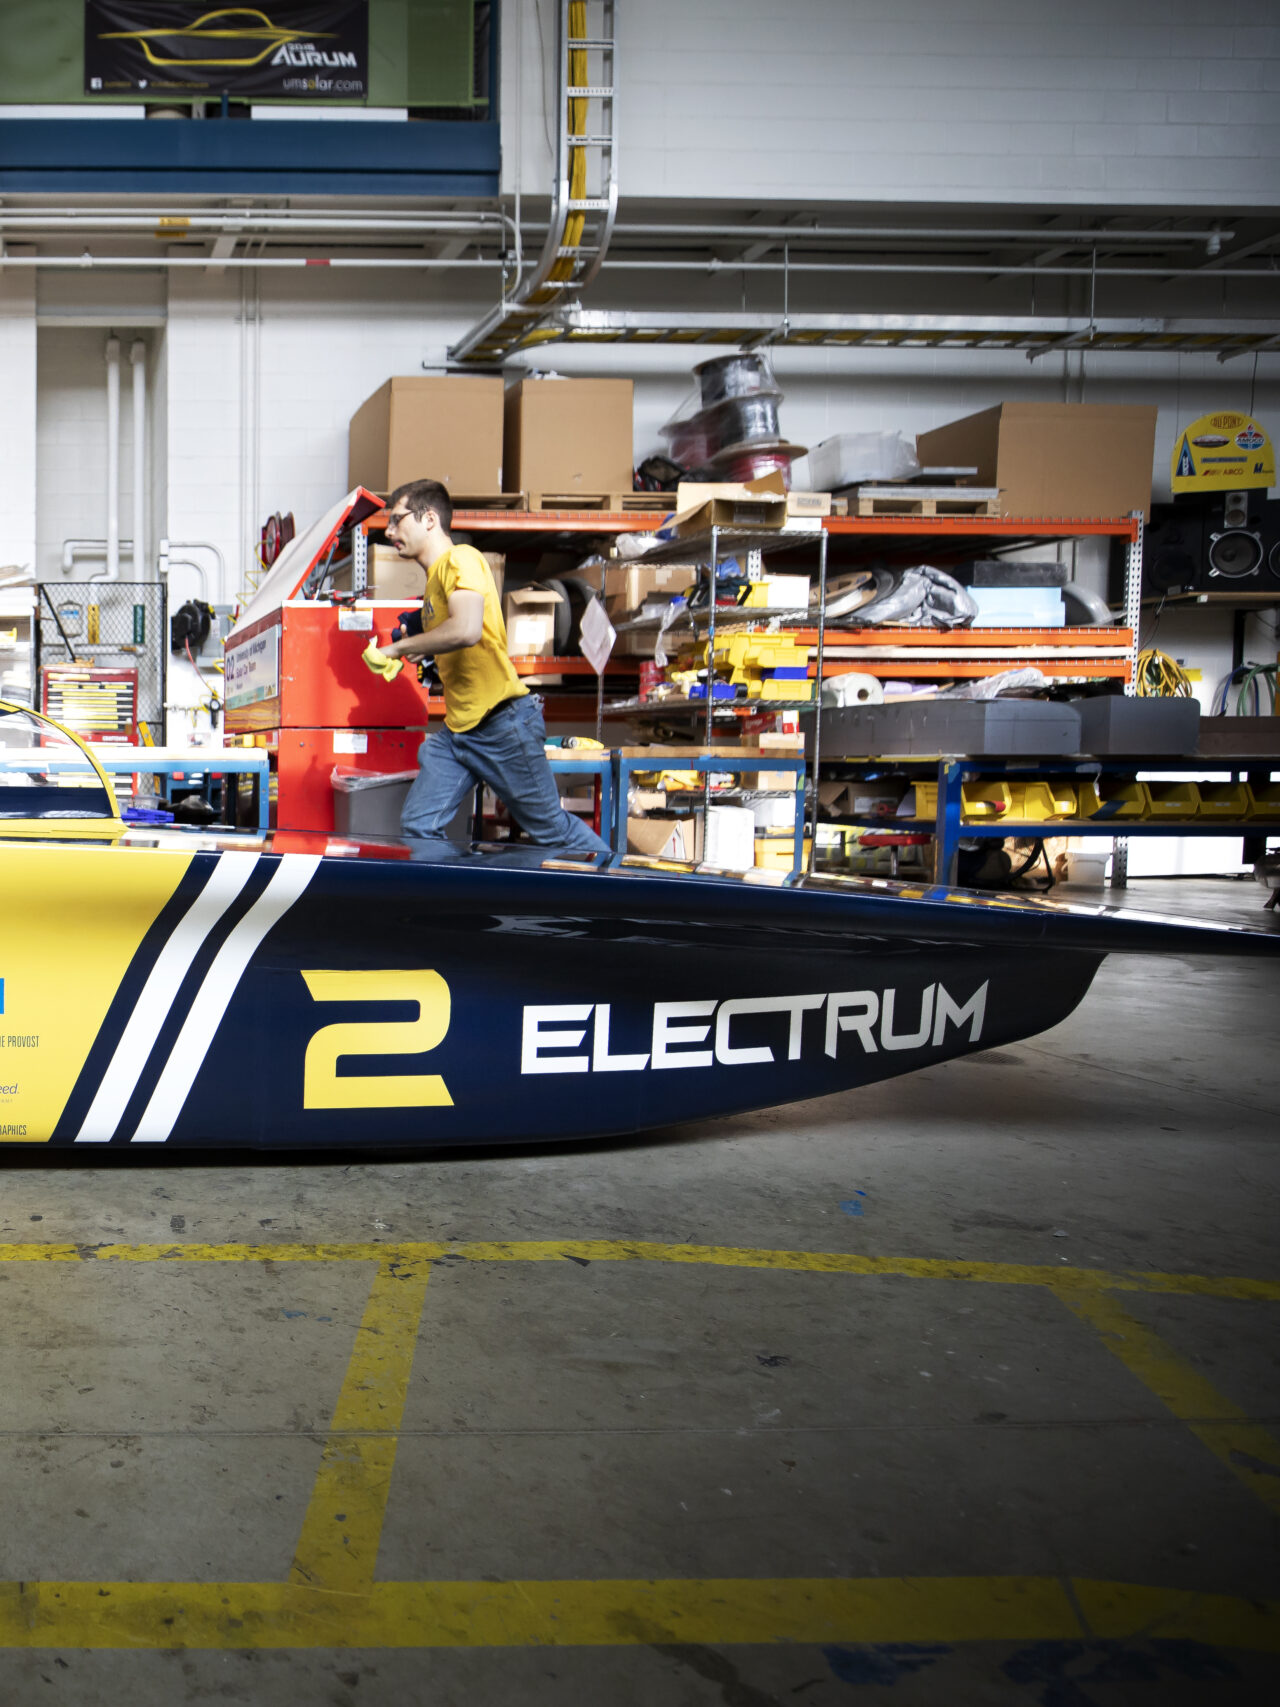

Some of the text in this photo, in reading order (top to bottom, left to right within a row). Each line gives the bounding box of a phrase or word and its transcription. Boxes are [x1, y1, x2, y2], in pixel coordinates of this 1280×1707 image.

[271, 44, 358, 68] AURUM
[283, 74, 363, 92] umsolar.com
[226, 654, 235, 682] 02
[300, 968, 454, 1109] 2
[520, 980, 989, 1074] ELECTRUM
[7, 1035, 40, 1048] PROVOST
